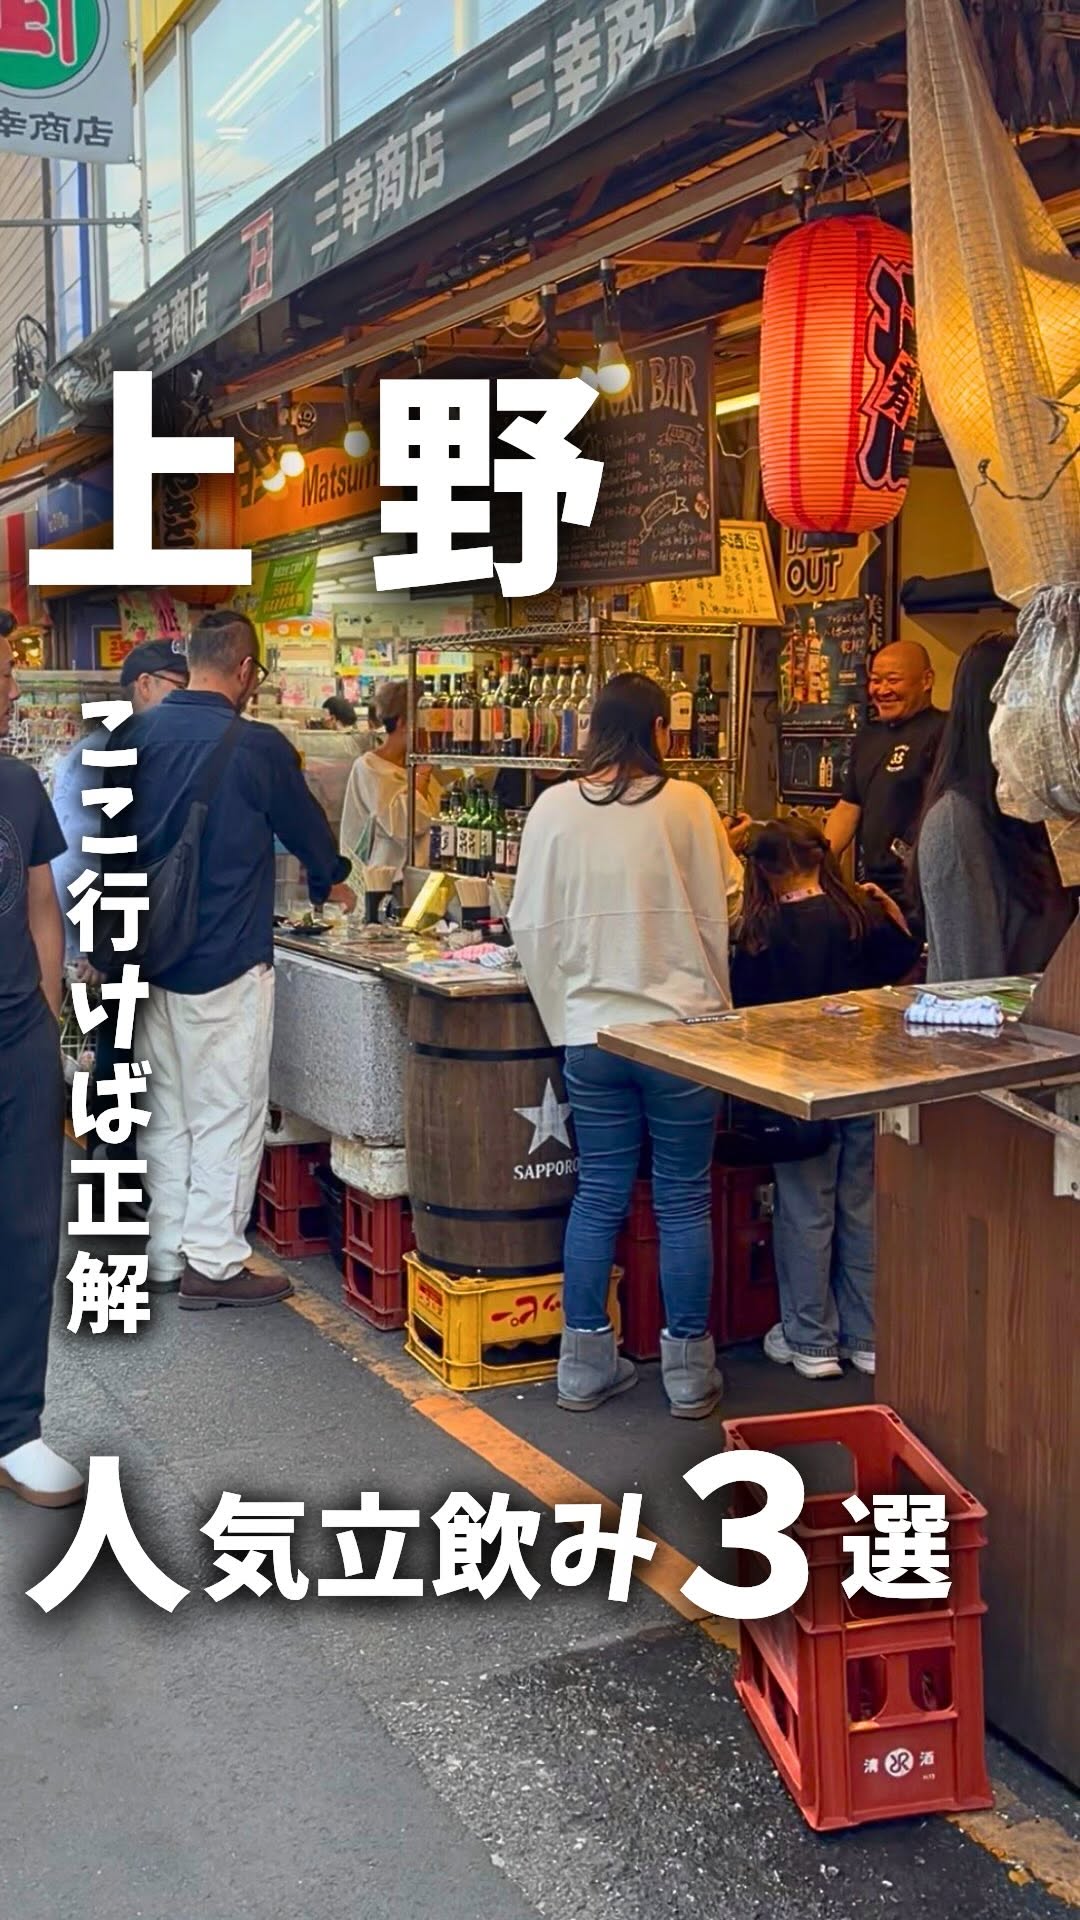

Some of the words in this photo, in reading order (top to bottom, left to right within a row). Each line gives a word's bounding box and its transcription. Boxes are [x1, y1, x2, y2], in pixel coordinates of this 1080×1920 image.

[311, 108, 445, 256] 三幸商店
[134, 272, 209, 372] 三幸商店
[649, 356, 699, 416] BAR
[785, 551, 843, 596] OUT
[513, 1157, 579, 1180] SAPPORO
